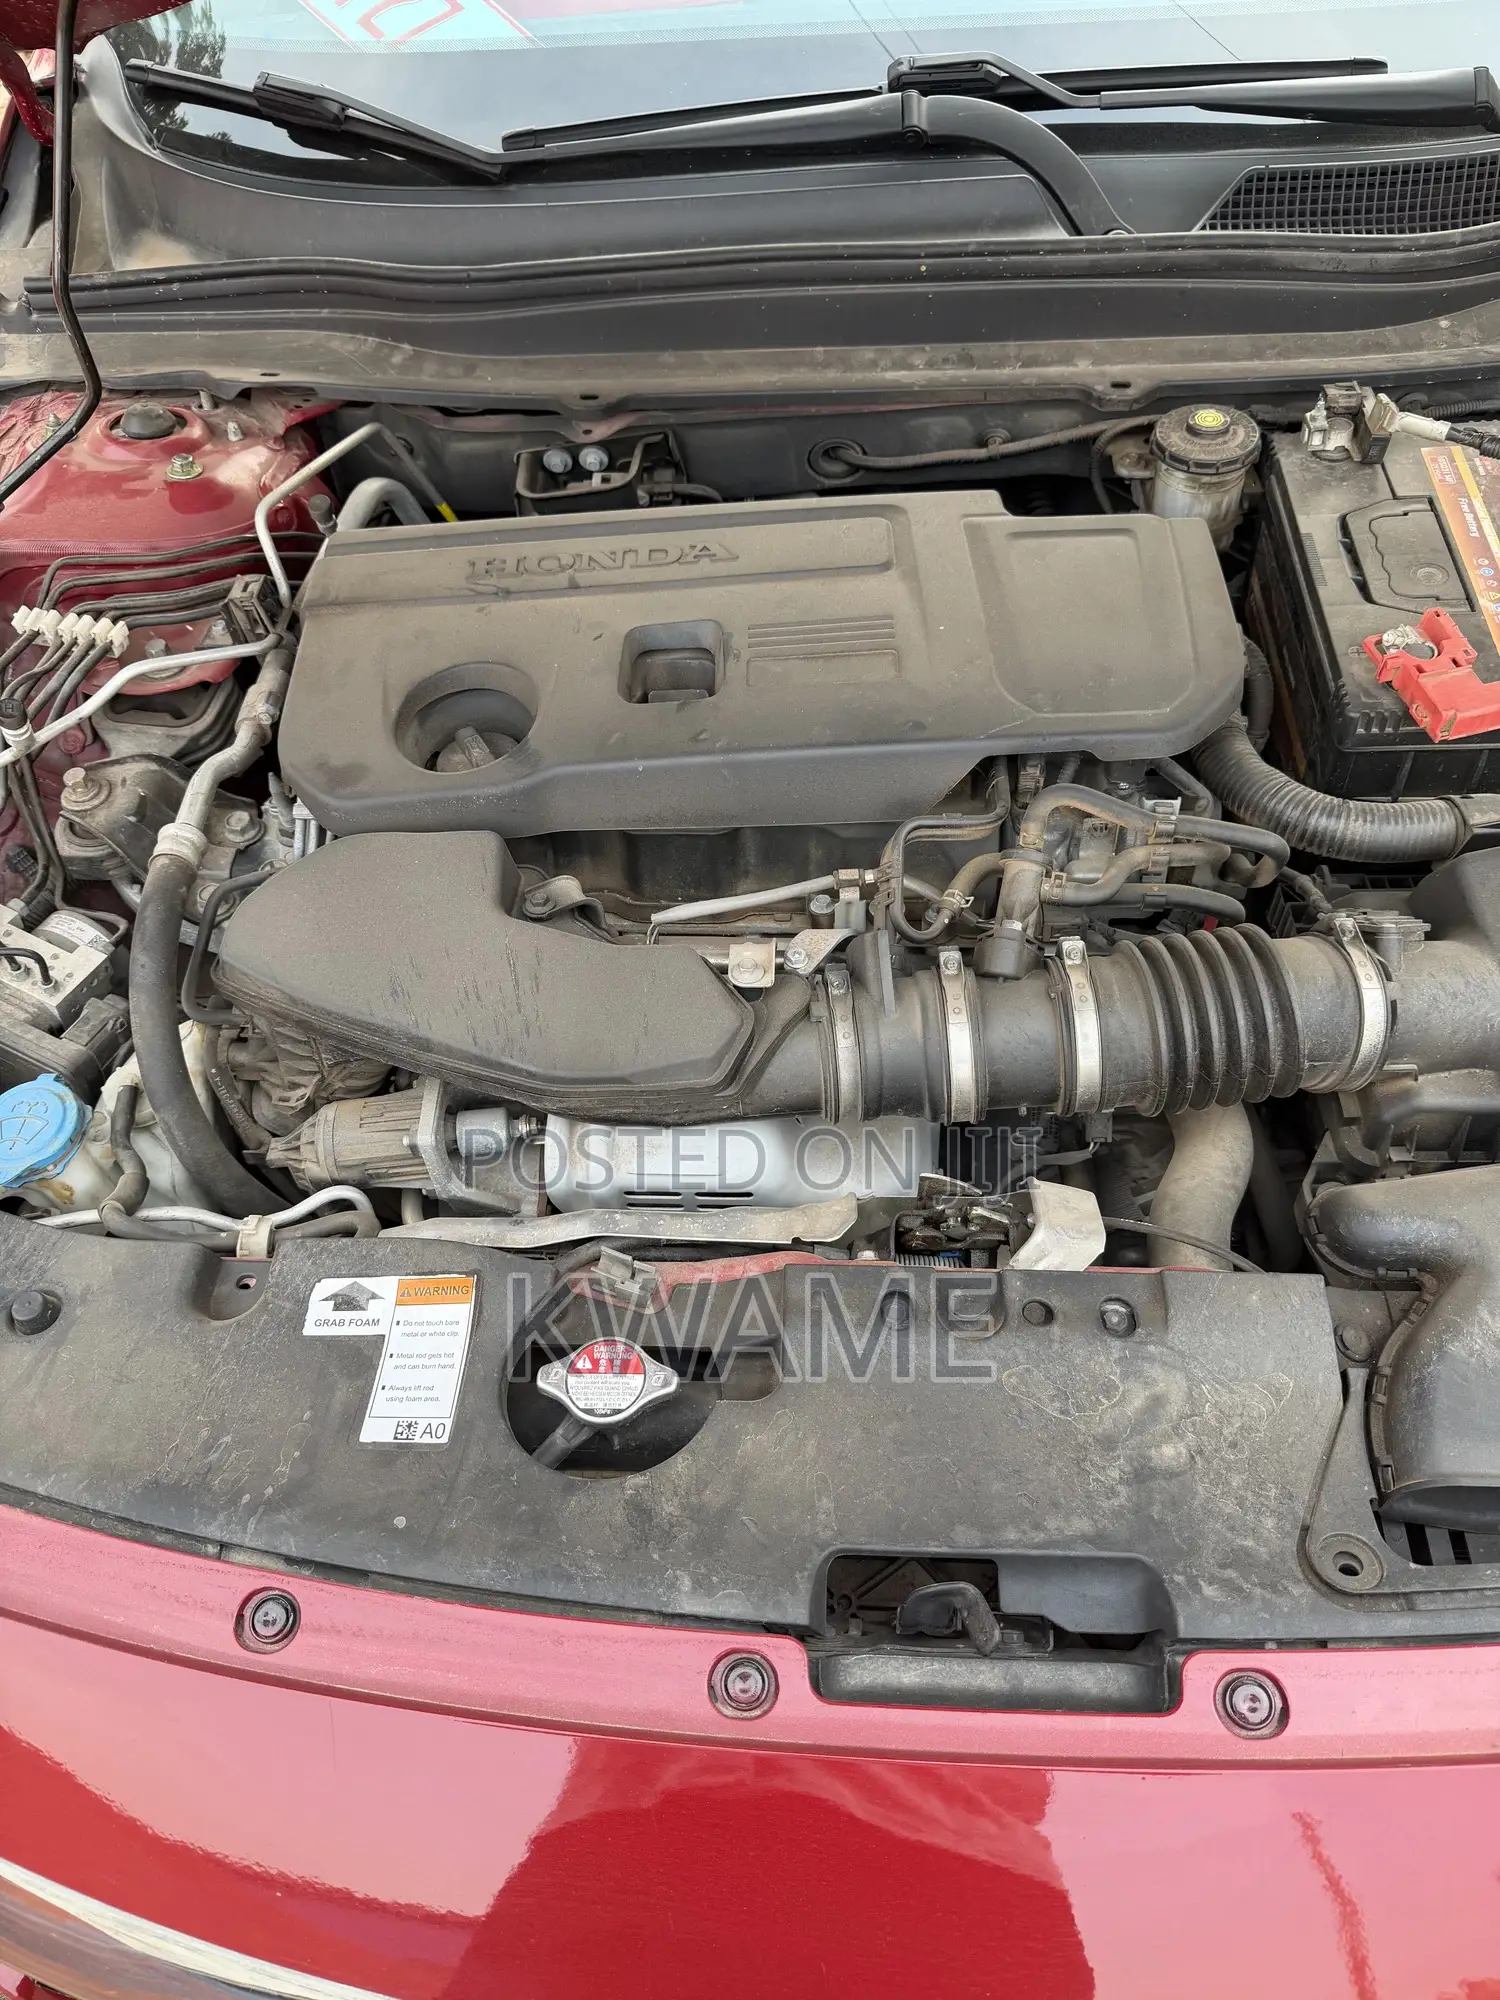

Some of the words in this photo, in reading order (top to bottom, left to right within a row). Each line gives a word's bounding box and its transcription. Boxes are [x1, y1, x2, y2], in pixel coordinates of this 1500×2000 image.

[1458, 497, 1469, 512] Free
[1463, 511, 1480, 538] Battery
[466, 543, 739, 578] HONDA
[414, 1285, 469, 1296] WARNING
[314, 1318, 346, 1327] GRAB
[348, 1318, 380, 1327] FOAM
[446, 1330, 460, 1338] clip.
[419, 1422, 446, 1439] A0
